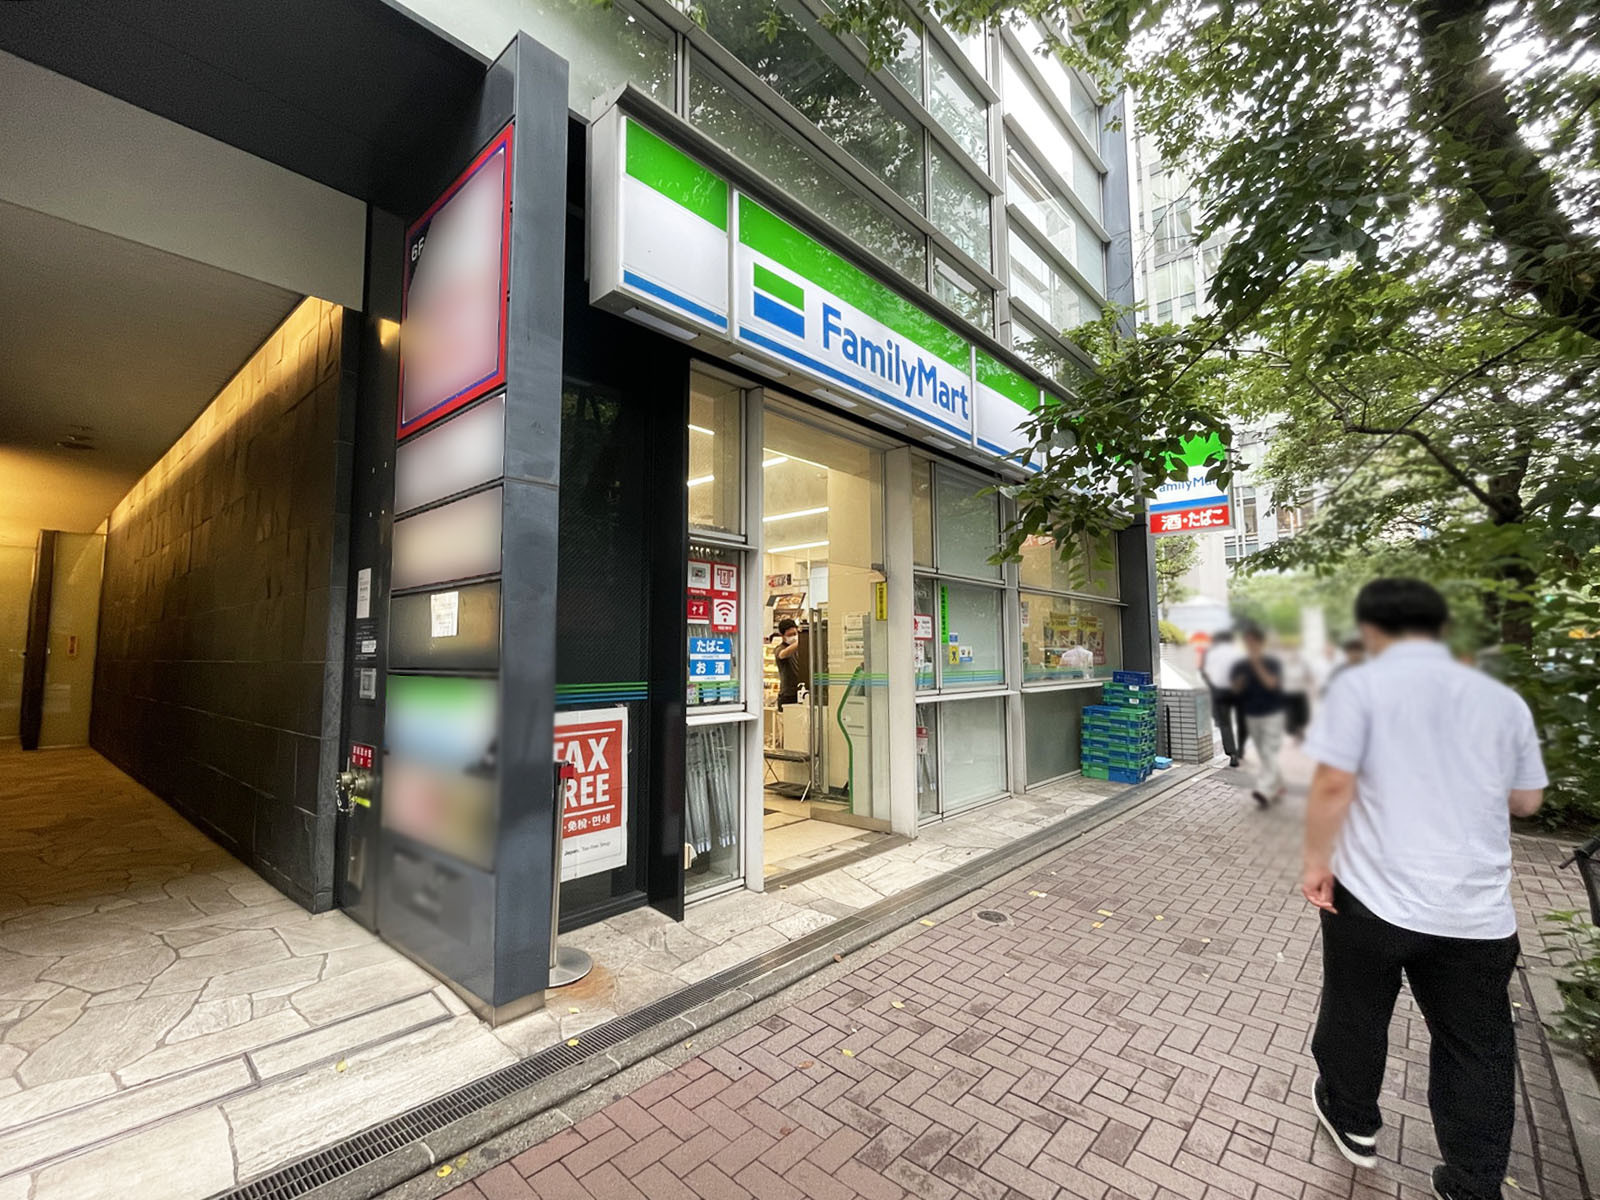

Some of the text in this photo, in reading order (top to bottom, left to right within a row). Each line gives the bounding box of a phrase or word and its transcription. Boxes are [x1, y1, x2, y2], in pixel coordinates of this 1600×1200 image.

[822, 302, 969, 421] FamilyMart
[696, 639, 725, 652] たばこ
[564, 773, 610, 809] REE
